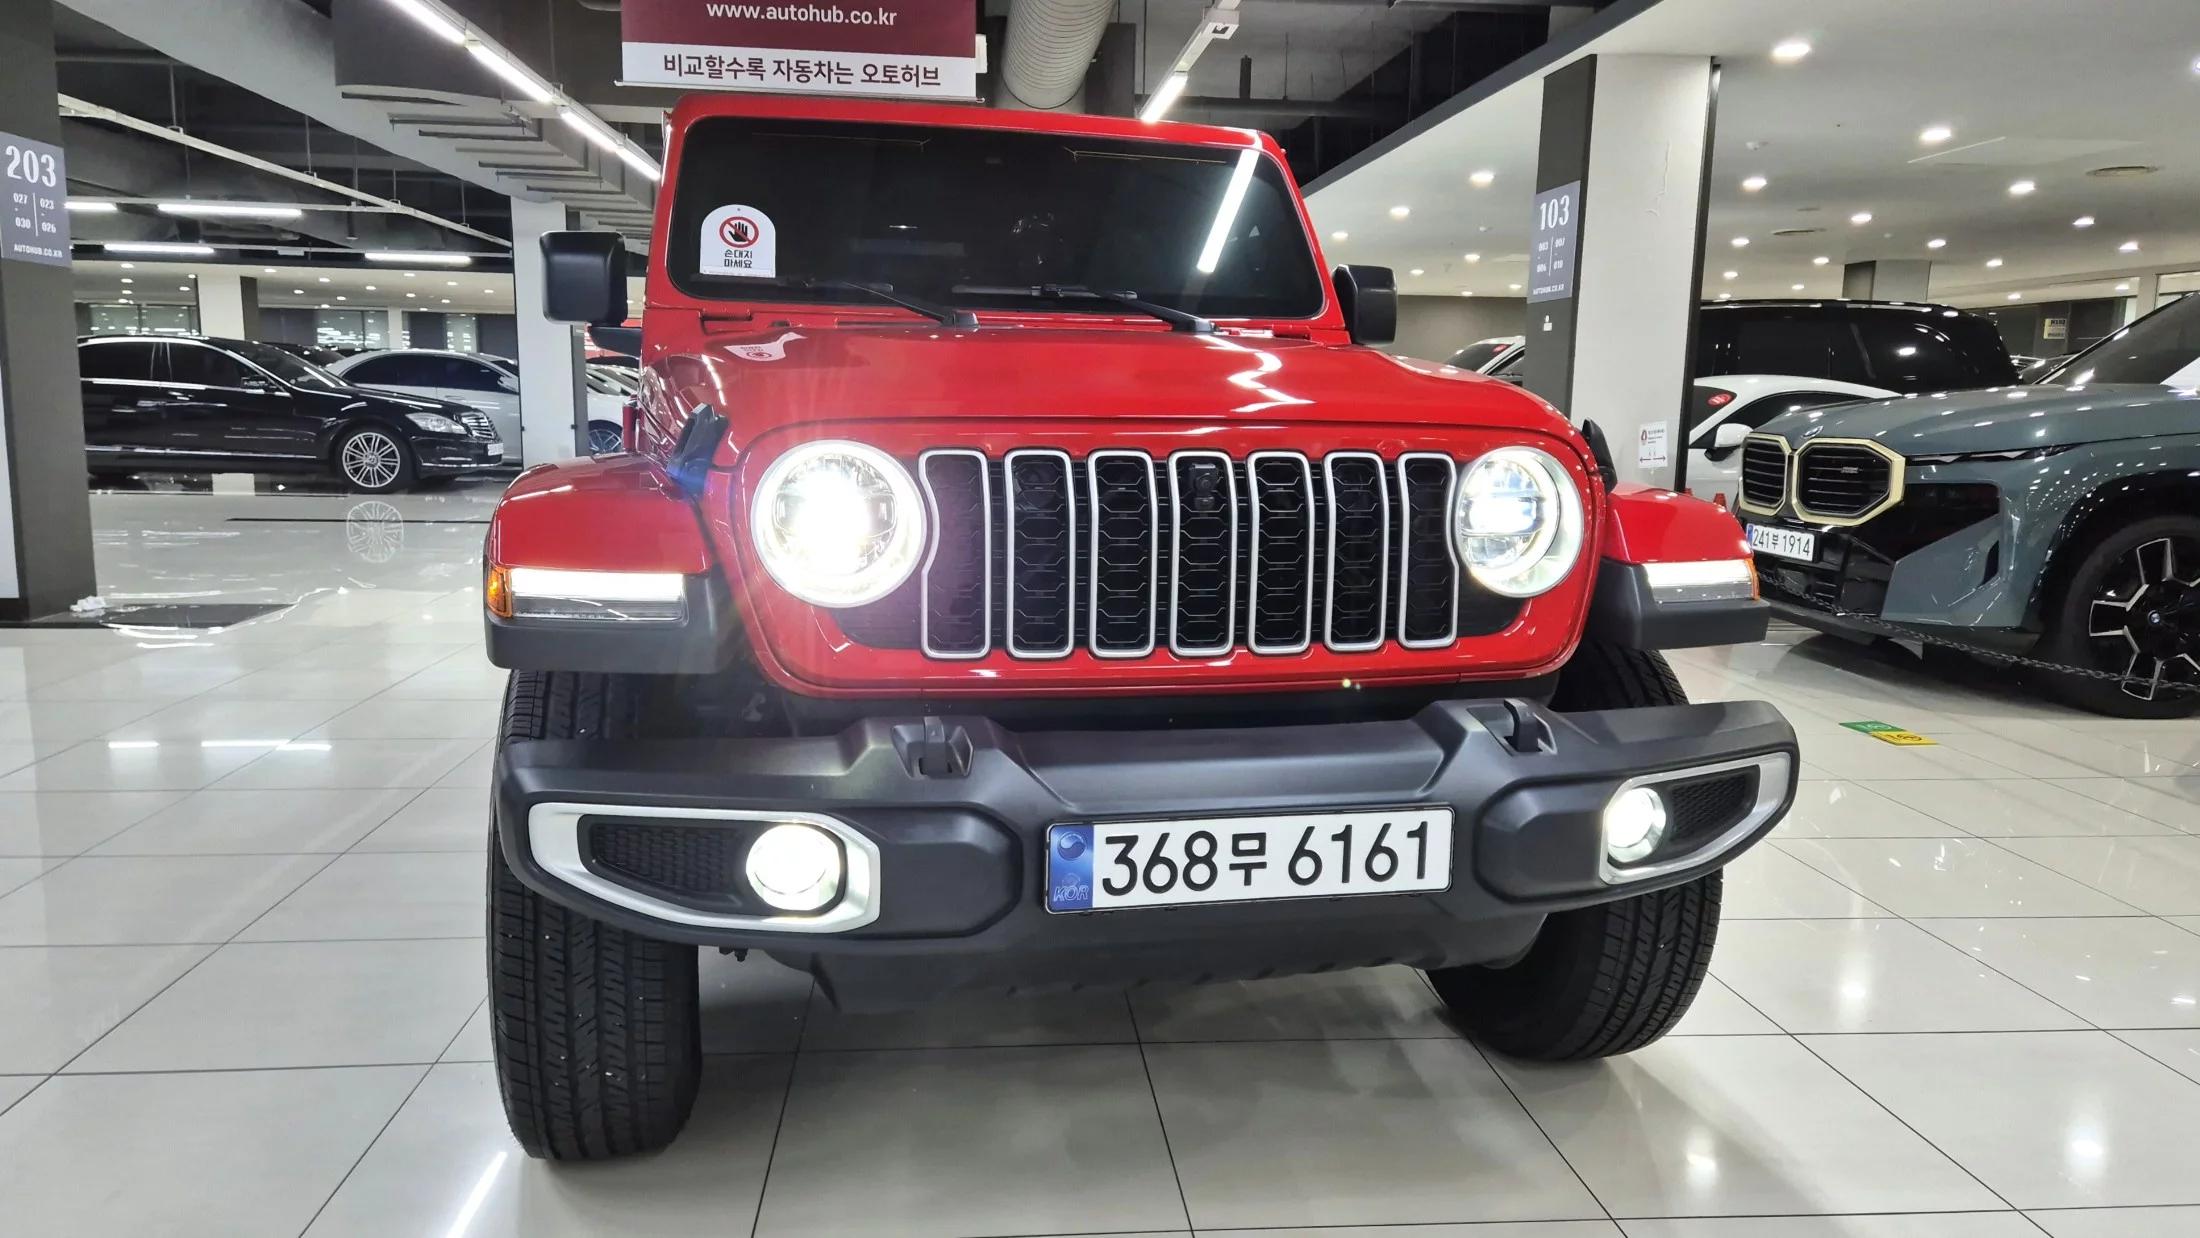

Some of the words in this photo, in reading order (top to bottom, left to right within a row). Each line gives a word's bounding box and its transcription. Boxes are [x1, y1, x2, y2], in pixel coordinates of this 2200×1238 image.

[706, 3, 898, 26] www.autohub.co.kr
[663, 54, 766, 81] 비교할수록
[772, 59, 854, 84] 자동차는
[860, 63, 941, 88] 오토허브
[5, 145, 57, 187] 203
[13, 192, 28, 205] 027
[39, 197, 55, 210] 023
[1539, 195, 1570, 231] 103
[15, 217, 31, 229] 030
[723, 258, 753, 269] 마세요
[724, 249, 753, 259] 손대지
[1782, 534, 1810, 556] 1914
[1102, 830, 1268, 897] 368무
[1287, 821, 1429, 886] 6161
[1053, 885, 1089, 902] KOR
